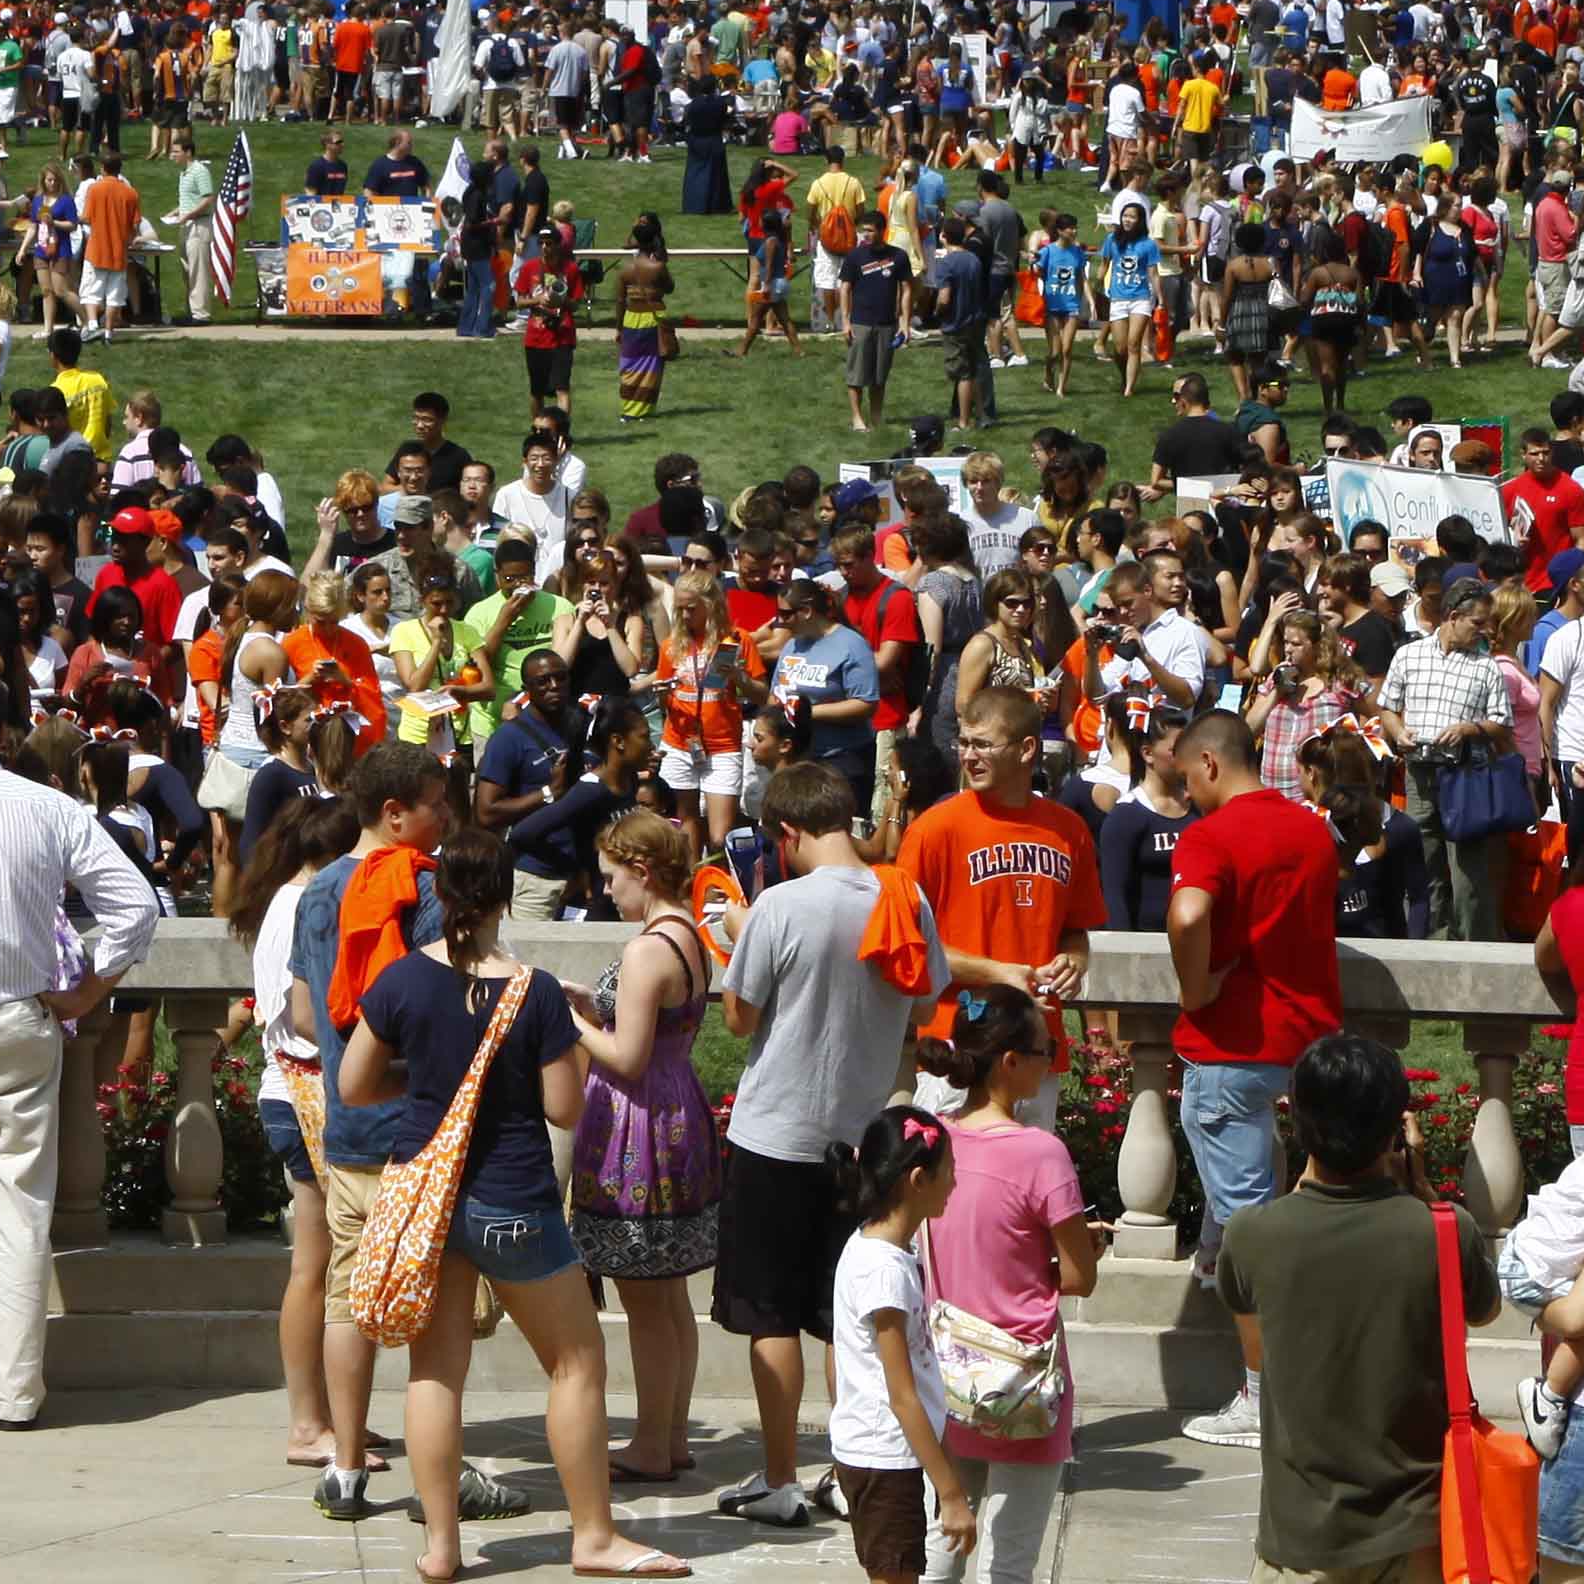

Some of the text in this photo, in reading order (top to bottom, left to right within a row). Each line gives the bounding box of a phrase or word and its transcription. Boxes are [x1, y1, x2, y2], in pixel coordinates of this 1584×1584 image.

[308, 251, 362, 265] ILLINI
[288, 298, 382, 314] VETERANS
[967, 842, 1072, 887] ILLINOIS
